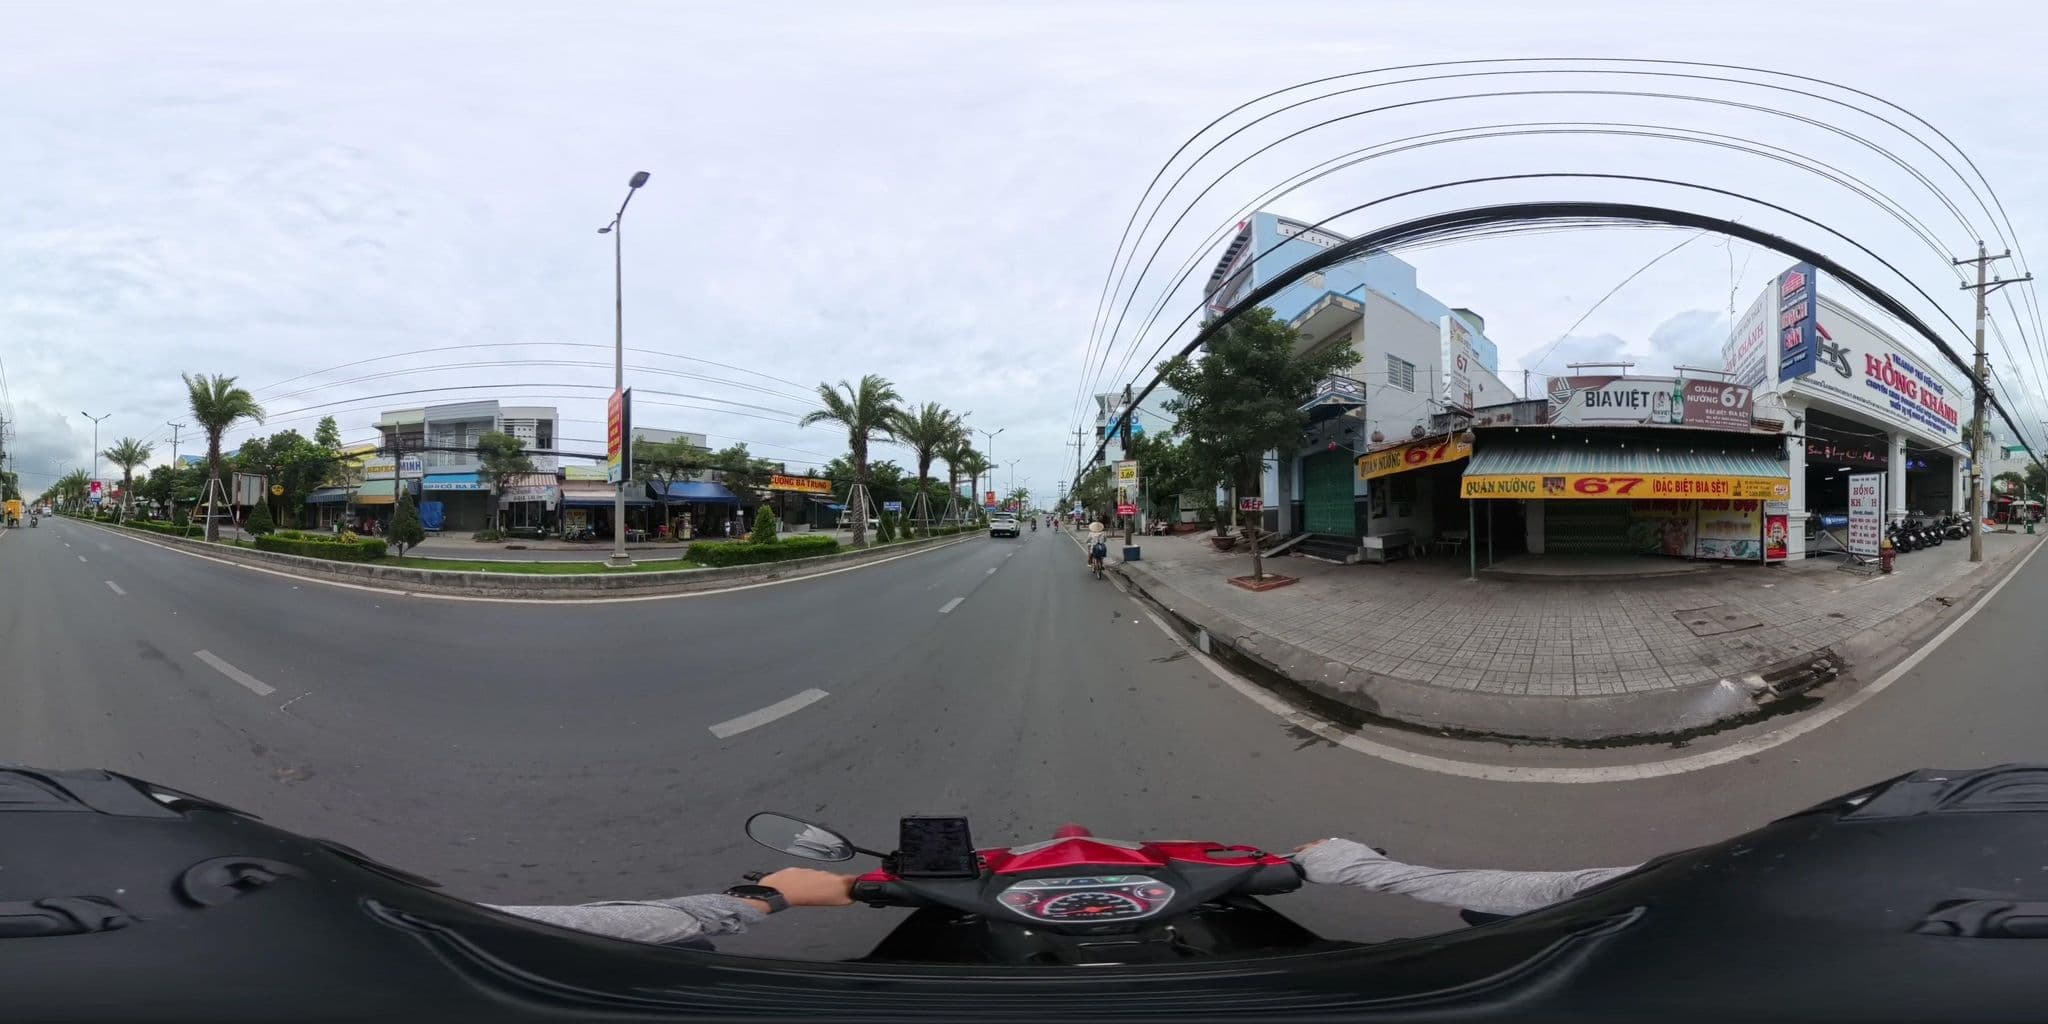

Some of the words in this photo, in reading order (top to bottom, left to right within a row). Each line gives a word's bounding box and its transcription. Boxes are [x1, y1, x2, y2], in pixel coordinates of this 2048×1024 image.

[1456, 353, 1468, 373] 67
[1584, 391, 1619, 408] BIA
[1618, 388, 1650, 410] VIỆT
[1694, 384, 1719, 394] QUÁN
[1720, 386, 1750, 409] 67
[1865, 353, 1918, 400] HỒNG
[1920, 386, 1958, 426] KHÁNH
[1404, 441, 1448, 465] 67
[1466, 478, 1495, 495] QUÁN
[1497, 477, 1536, 494] NƯỚNG
[1573, 477, 1644, 495] 67
[1675, 478, 1693, 496] BIỆT
[1696, 480, 1709, 494] BIA
